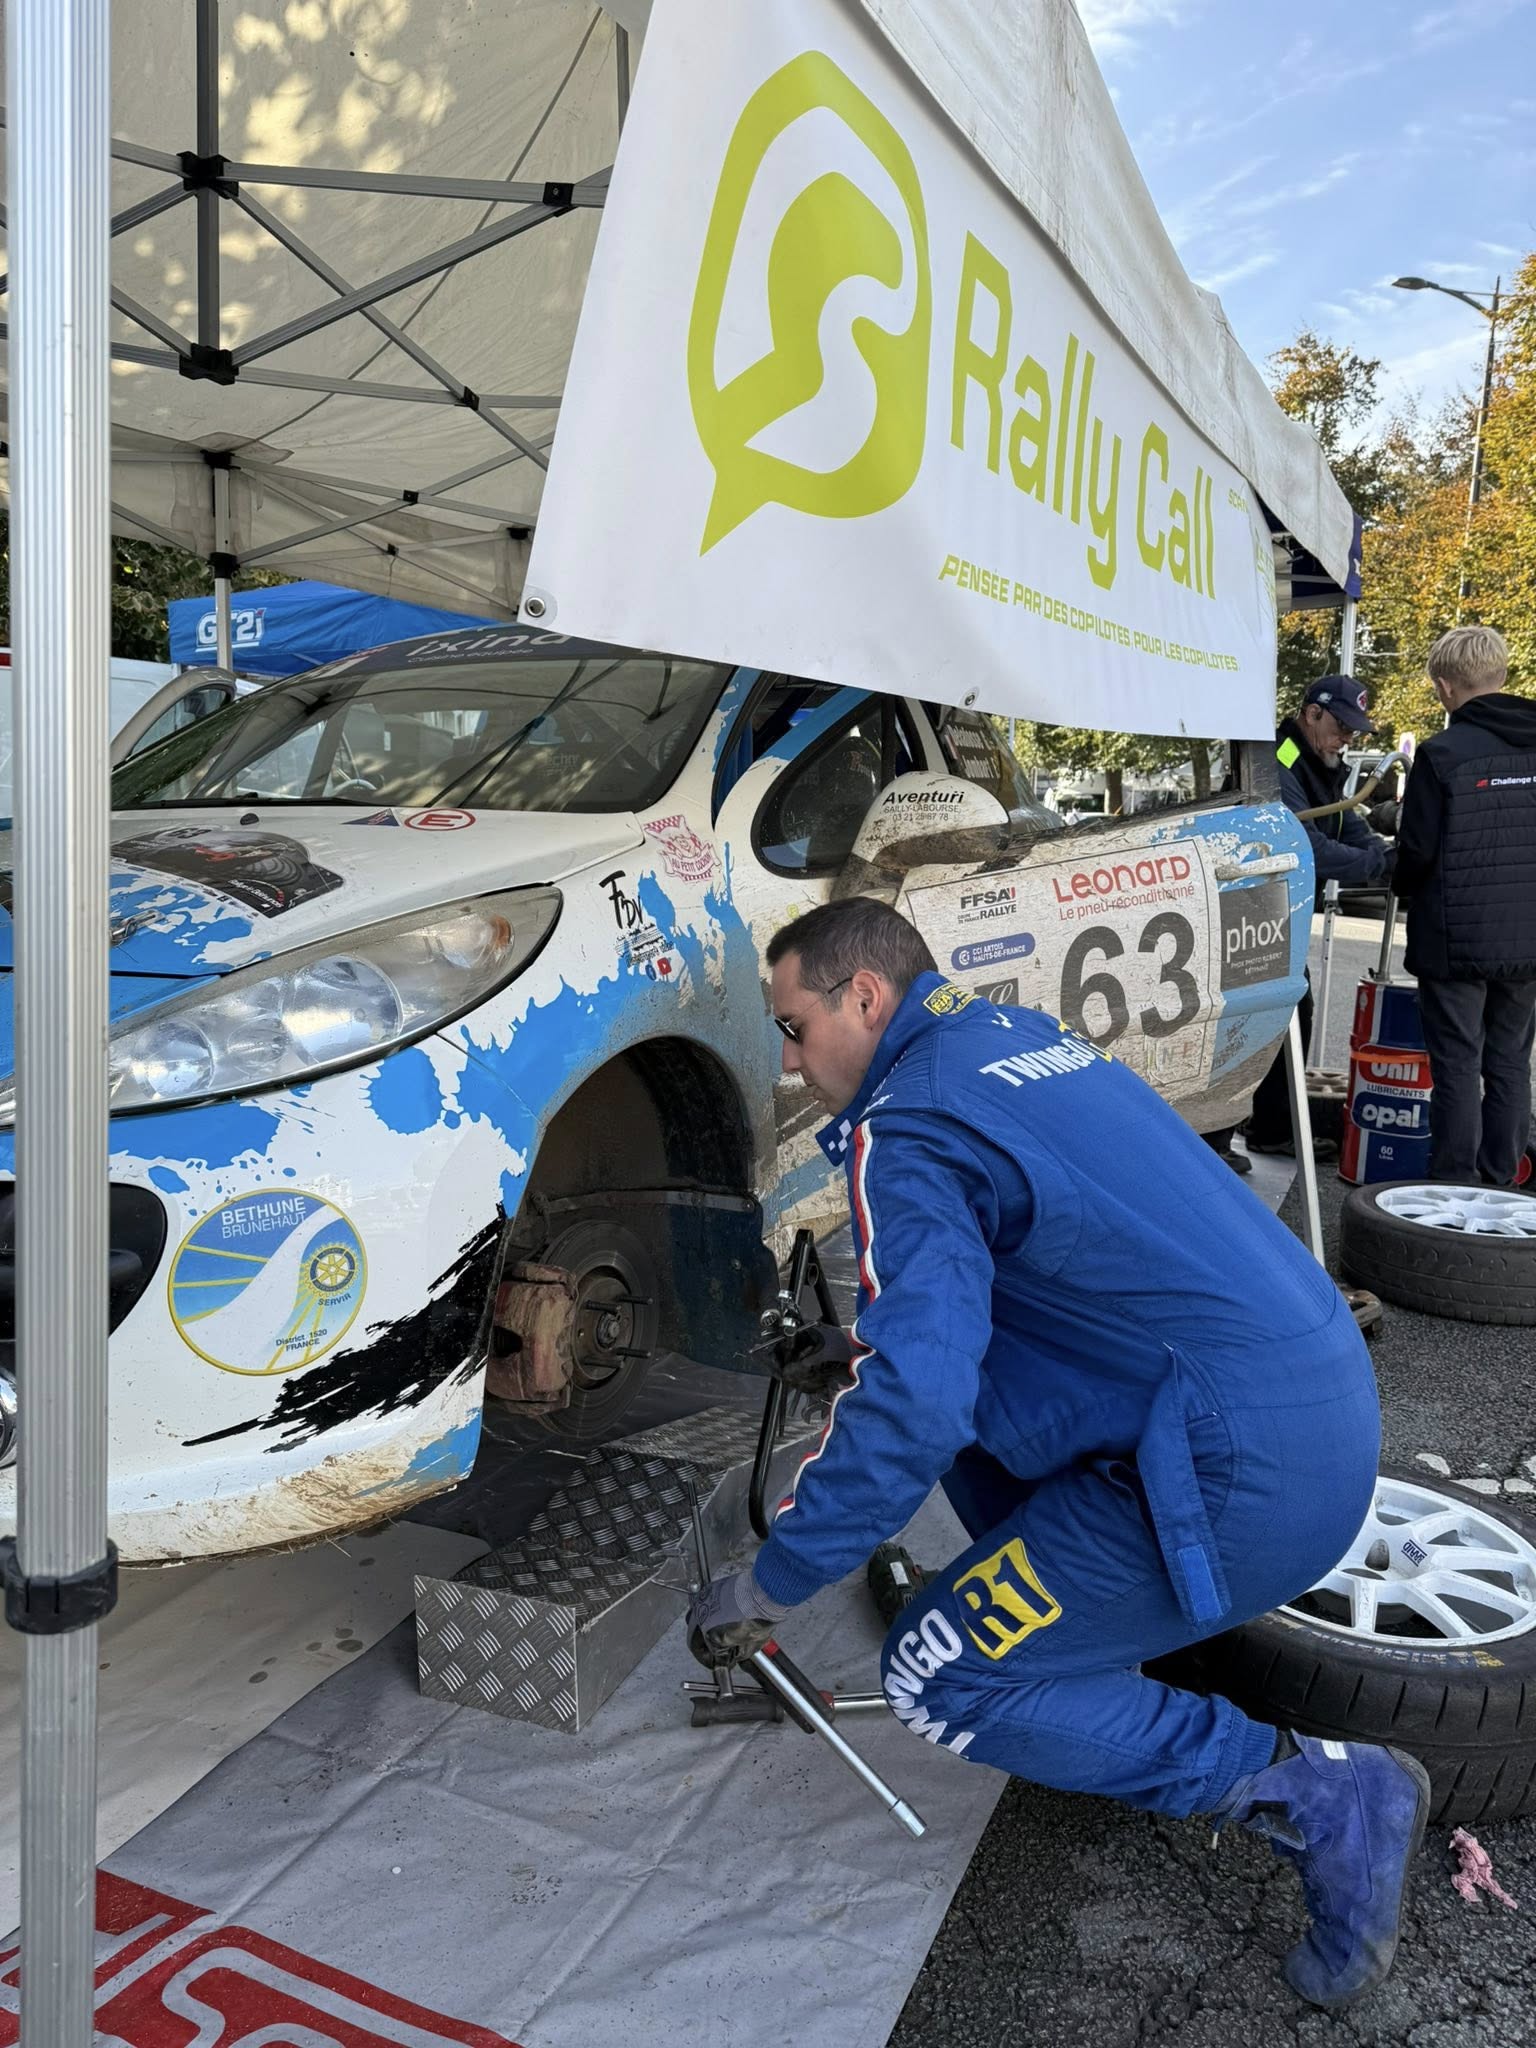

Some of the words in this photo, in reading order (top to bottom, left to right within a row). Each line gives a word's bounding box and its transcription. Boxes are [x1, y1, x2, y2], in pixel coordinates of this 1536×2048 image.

[950, 229, 1121, 591] Rally
[1136, 421, 1216, 600] Call
[937, 553, 1009, 604] PENSÉE
[1013, 582, 1041, 615] PAR
[1044, 596, 1068, 625] DES
[1134, 631, 1162, 656] POUR
[1164, 640, 1183, 662] LES
[1491, 777, 1532, 787] Challenge
[882, 789, 965, 806] Aventuri
[960, 887, 1011, 909] FFSA
[980, 904, 1016, 919] RALLYE
[1059, 906, 1075, 921] Le
[1077, 901, 1109, 920] pneu
[984, 942, 1004, 954] ARTOIS
[1227, 917, 1285, 963] phox
[972, 945, 1026, 963] HAUTS-DE-FRANCE
[1060, 912, 1201, 1049] 63
[979, 1038, 1097, 1088] TWINGO
[1366, 1083, 1425, 1098] LUBRICANTS
[1362, 1104, 1421, 1129] opal
[1381, 1146, 1393, 1155] 60
[221, 1196, 306, 1226] BETHUNE
[221, 1211, 307, 1239] BRUNEHAUT
[317, 1292, 352, 1307] SERVIR
[275, 1334, 306, 1346] District
[309, 1328, 328, 1339] 1520
[286, 1337, 321, 1351] FRANCE
[953, 1552, 1055, 1653] R1
